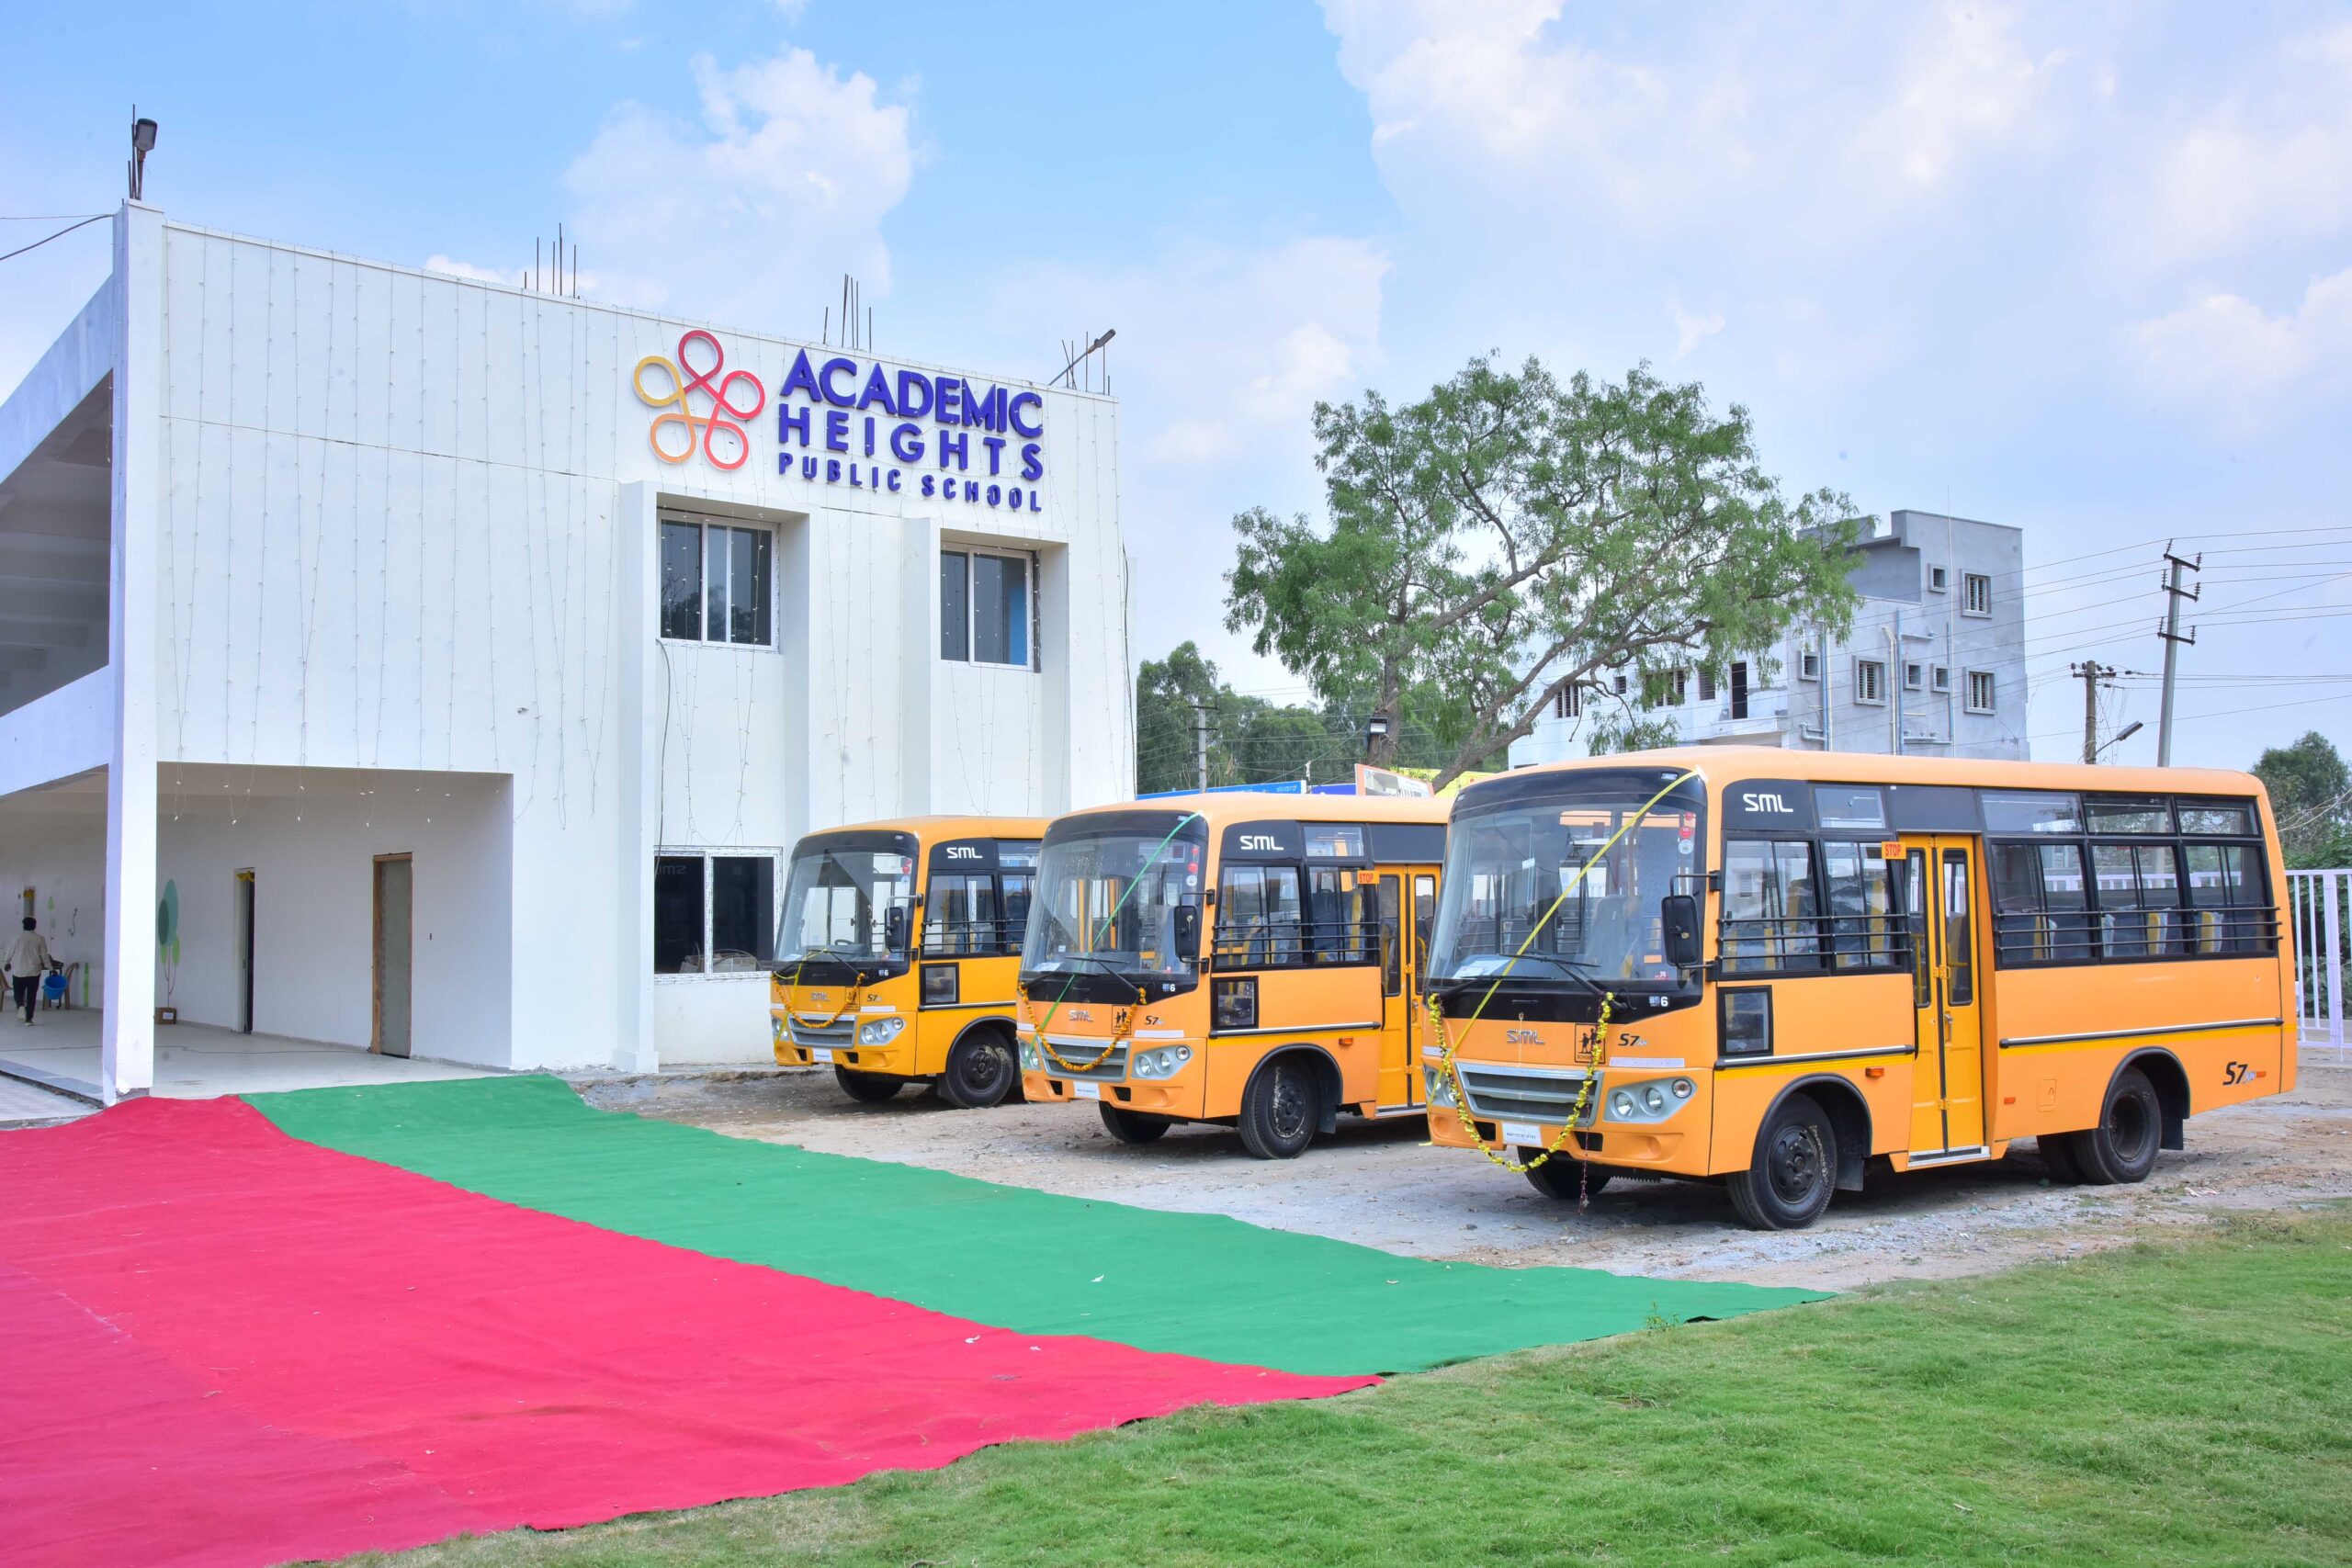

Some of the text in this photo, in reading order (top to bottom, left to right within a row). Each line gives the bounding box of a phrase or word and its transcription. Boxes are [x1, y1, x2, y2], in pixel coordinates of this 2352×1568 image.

[780, 348, 1044, 438] ACADEMIC
[778, 403, 1044, 481] HEIGHTS
[778, 452, 1043, 512] PUBLIC SCHOOL
[1742, 793, 1794, 813] SML
[1239, 835, 1284, 851] SML
[1884, 843, 1902, 857] STOP
[946, 847, 983, 859] SML
[1359, 873, 1374, 884] STOP
[1506, 1028, 1545, 1044] SML
